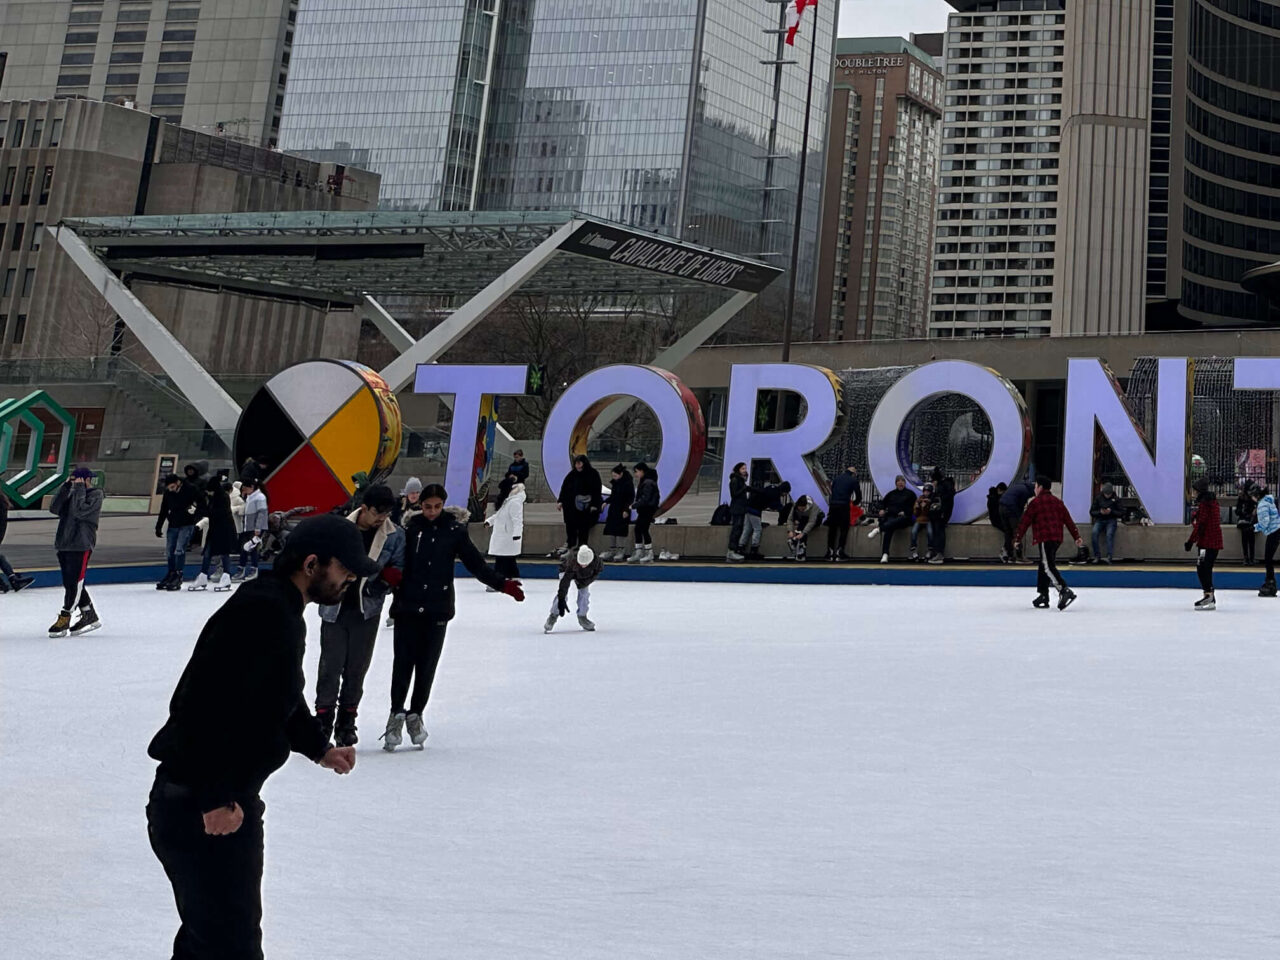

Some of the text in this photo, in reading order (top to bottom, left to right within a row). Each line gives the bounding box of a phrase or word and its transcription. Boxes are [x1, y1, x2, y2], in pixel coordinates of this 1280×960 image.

[610, 238, 694, 274] CAVALCADE
[677, 254, 710, 279] OF
[692, 258, 745, 285] LIGHTS
